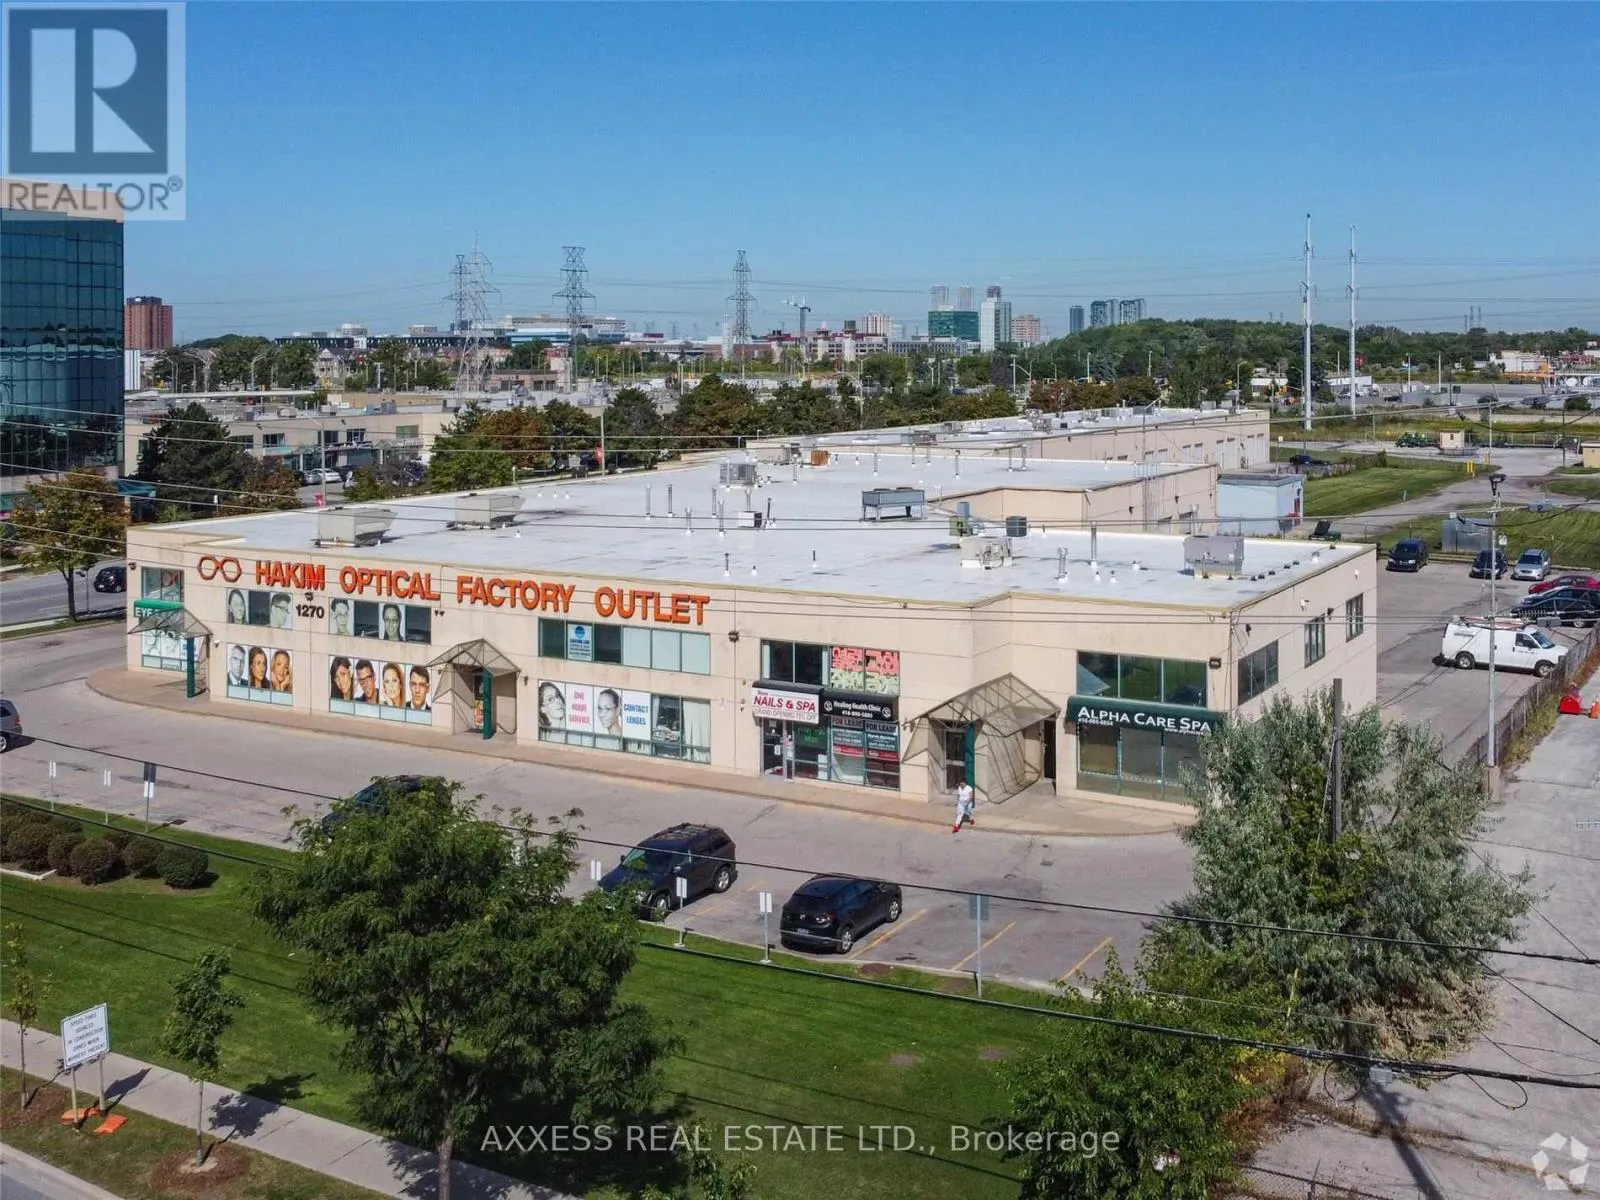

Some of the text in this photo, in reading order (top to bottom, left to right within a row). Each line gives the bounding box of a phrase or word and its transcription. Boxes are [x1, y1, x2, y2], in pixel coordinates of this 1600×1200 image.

[255, 559, 711, 625] HAKIM OPTICAL FACTORY OUTLET
[295, 603, 325, 620] 1270
[623, 703, 649, 713] CONTACT
[753, 695, 816, 712] NAILS & SPA
[626, 716, 646, 725] LENSES
[1078, 706, 1212, 732] ALPHA CARE SPA
